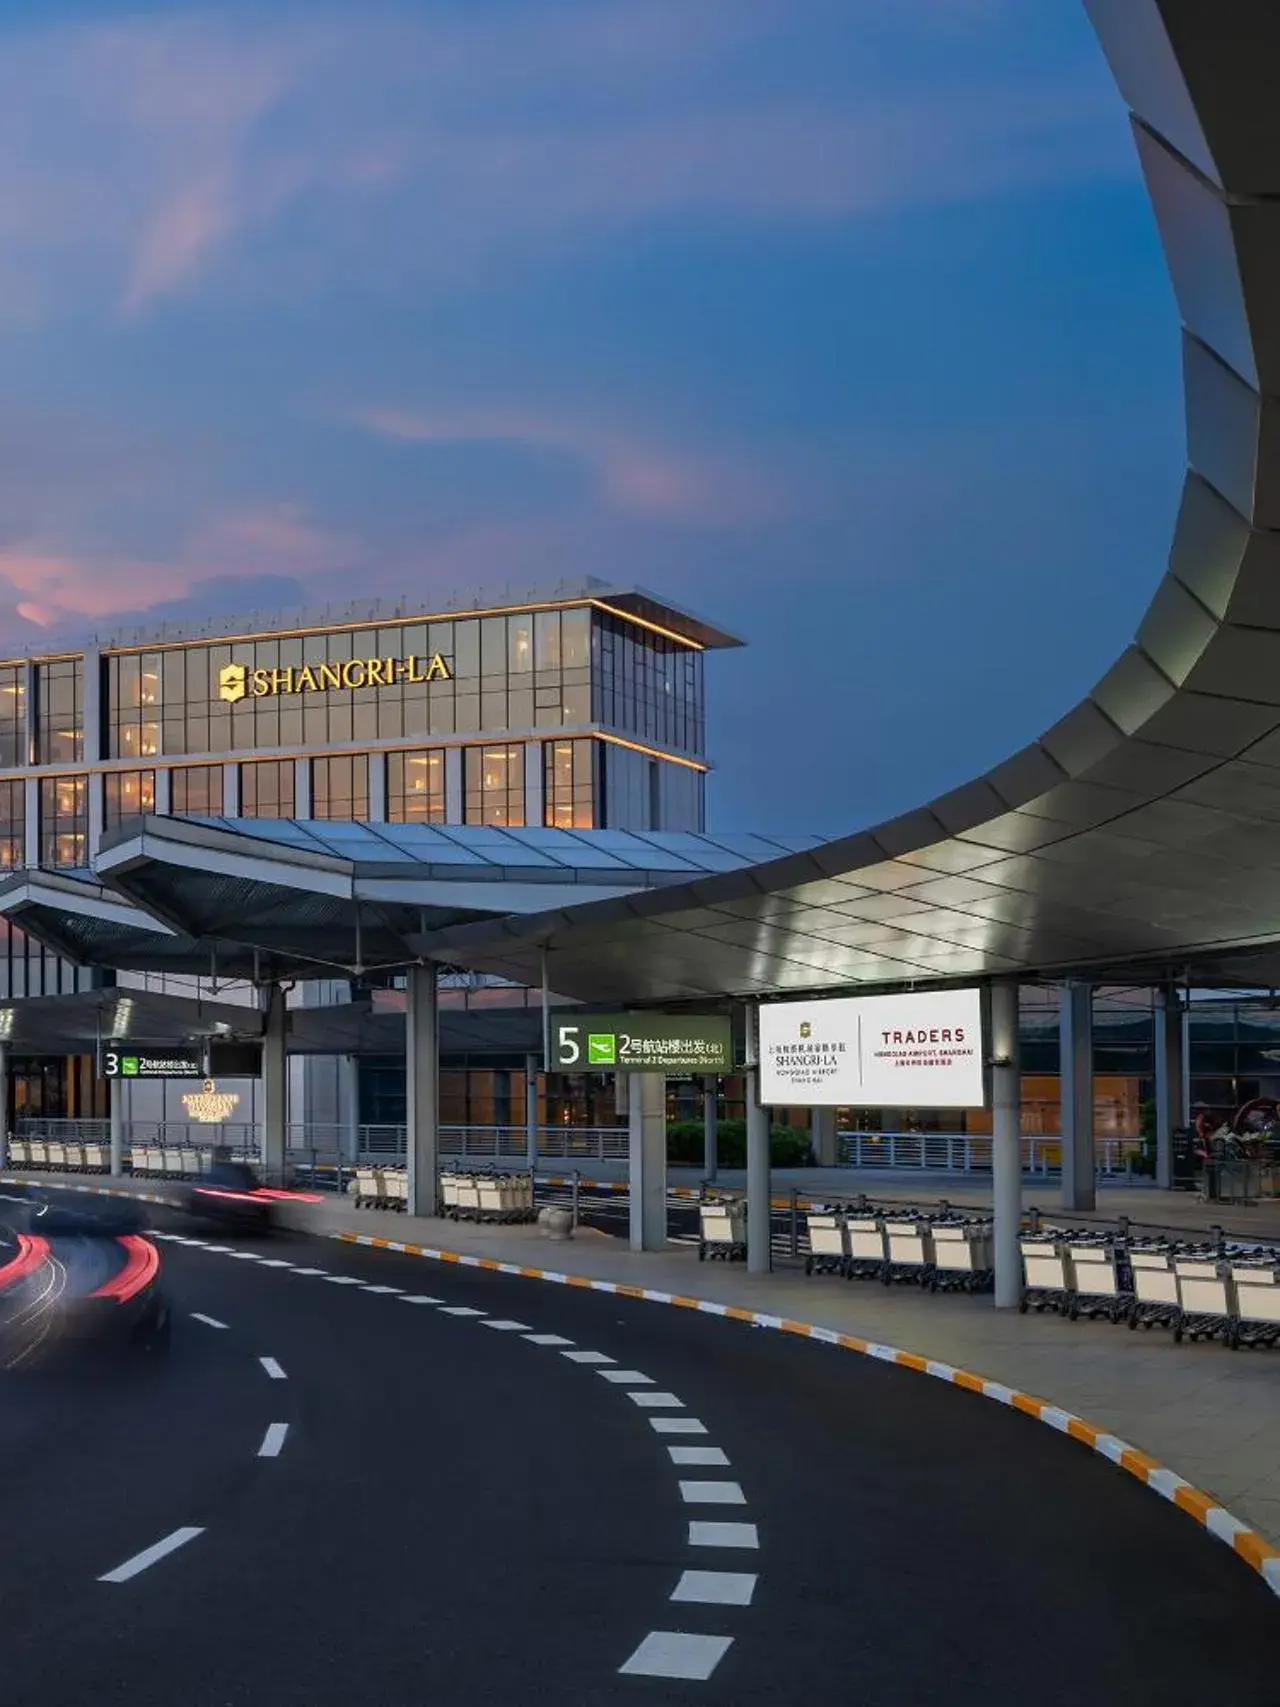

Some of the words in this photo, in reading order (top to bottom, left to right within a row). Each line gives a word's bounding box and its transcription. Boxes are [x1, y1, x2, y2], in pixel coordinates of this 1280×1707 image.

[253, 652, 451, 696] SHANGRI-LA
[559, 1027, 580, 1064] 5
[882, 1028, 965, 1044] TRADERS
[105, 1053, 119, 1075] 3
